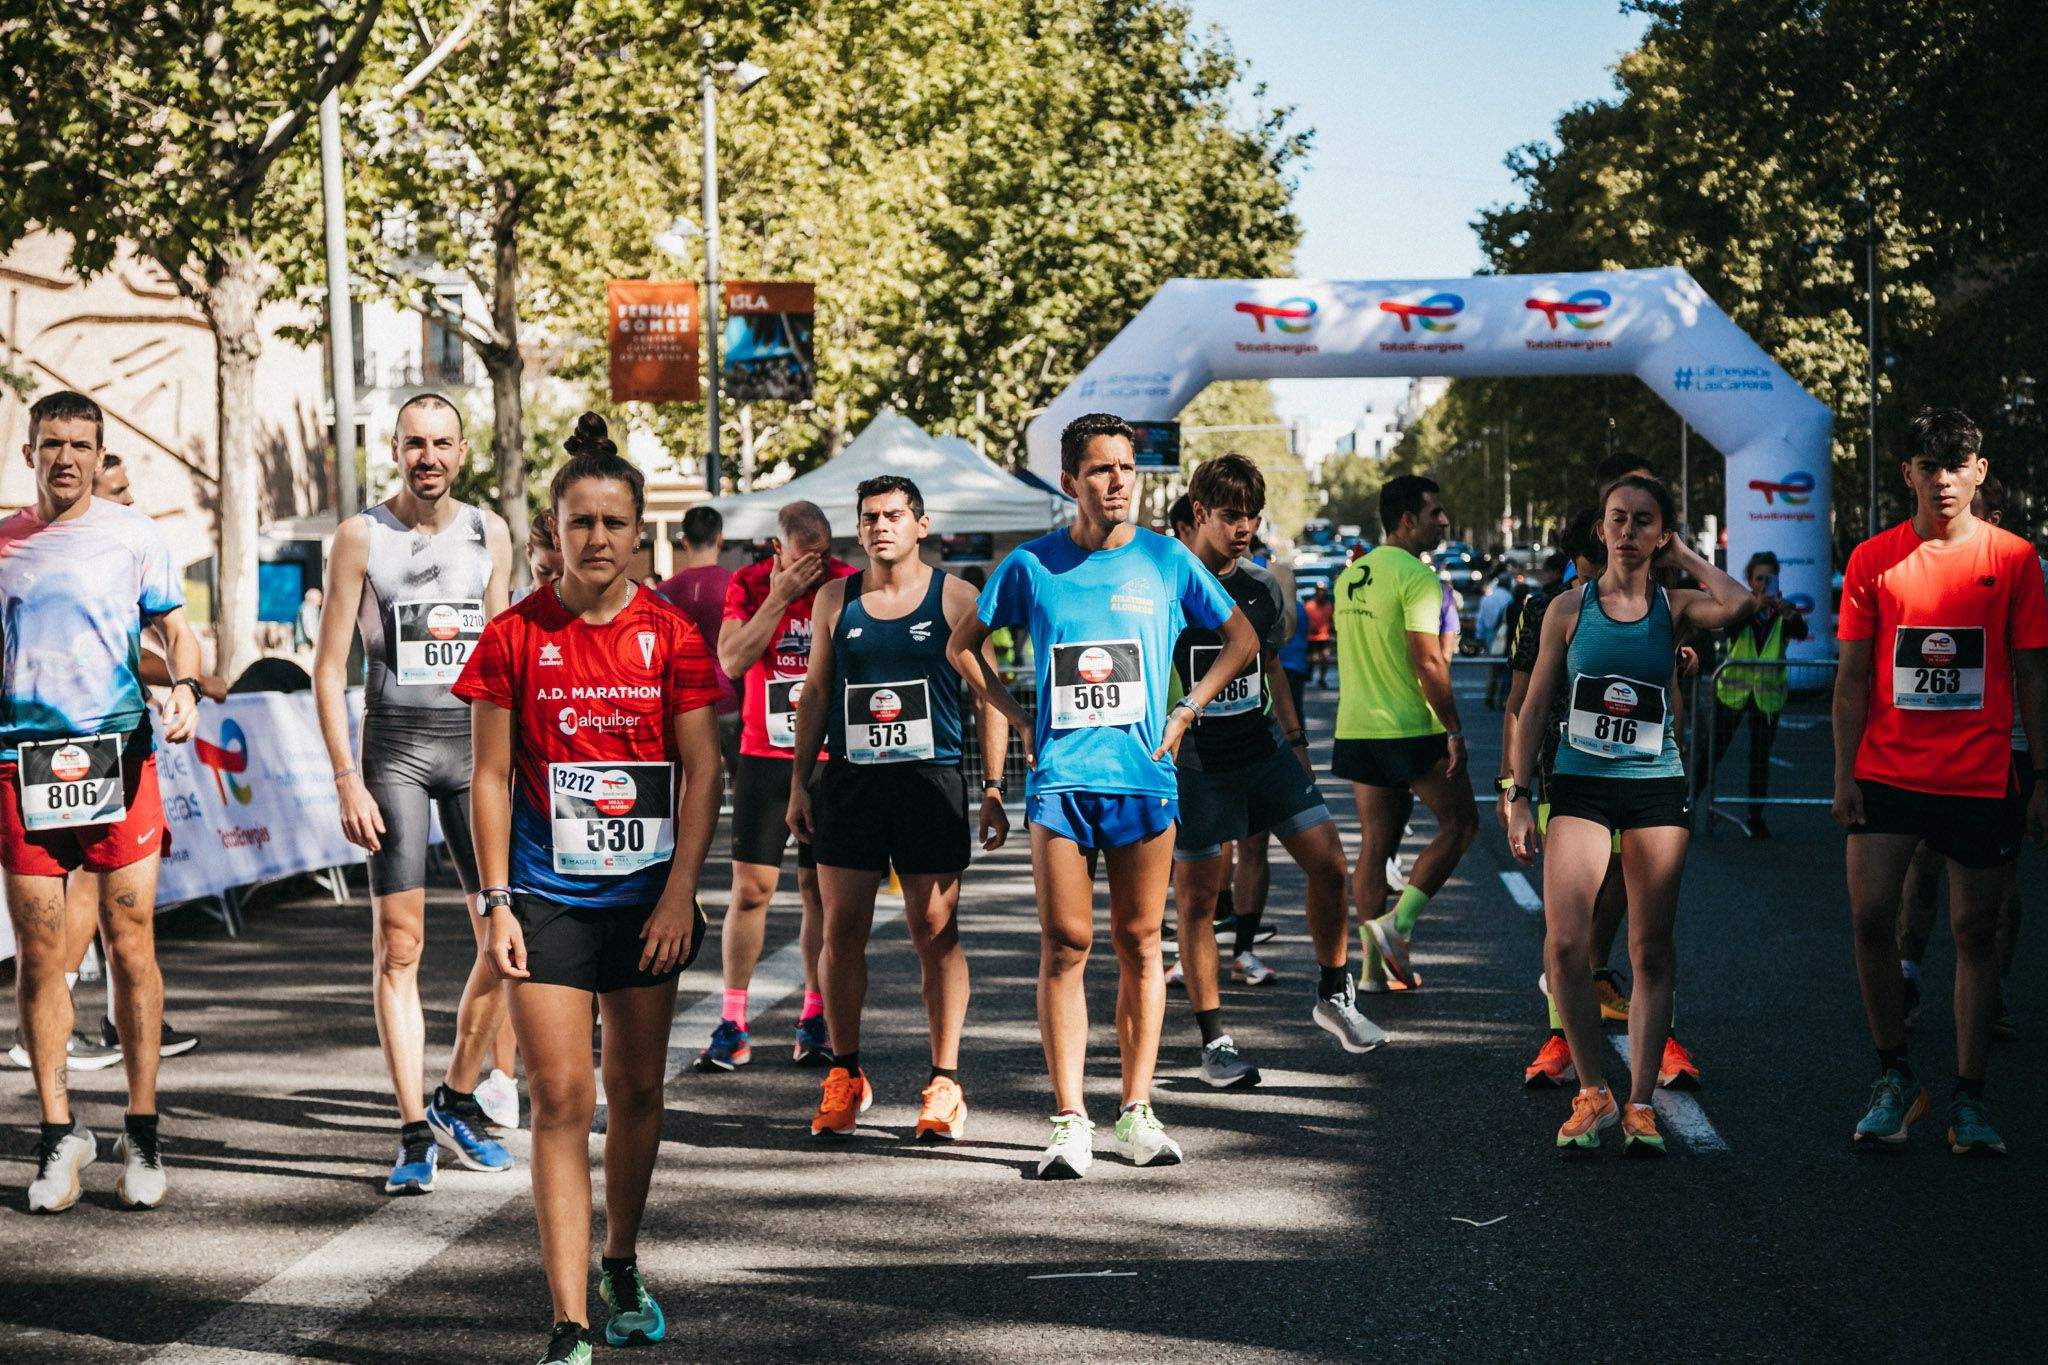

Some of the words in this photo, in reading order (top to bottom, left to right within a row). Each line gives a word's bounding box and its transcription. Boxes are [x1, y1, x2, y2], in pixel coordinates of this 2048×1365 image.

[1235, 342, 1318, 355] TotalEnergies
[1379, 341, 1464, 354] TotalEnergies
[1524, 338, 1612, 352] TotalEnergies
[425, 643, 466, 666] 602
[777, 655, 796, 667] LOS
[537, 687, 568, 701] A.D.
[571, 685, 662, 700] MARATHON
[1914, 668, 1961, 694] 263
[1074, 684, 1121, 710] 569
[578, 708, 642, 734] alquiber
[1594, 715, 1639, 745] 816
[868, 723, 908, 748] 573
[557, 769, 595, 794] 3212
[48, 781, 98, 809] 806
[586, 819, 645, 852] 530
